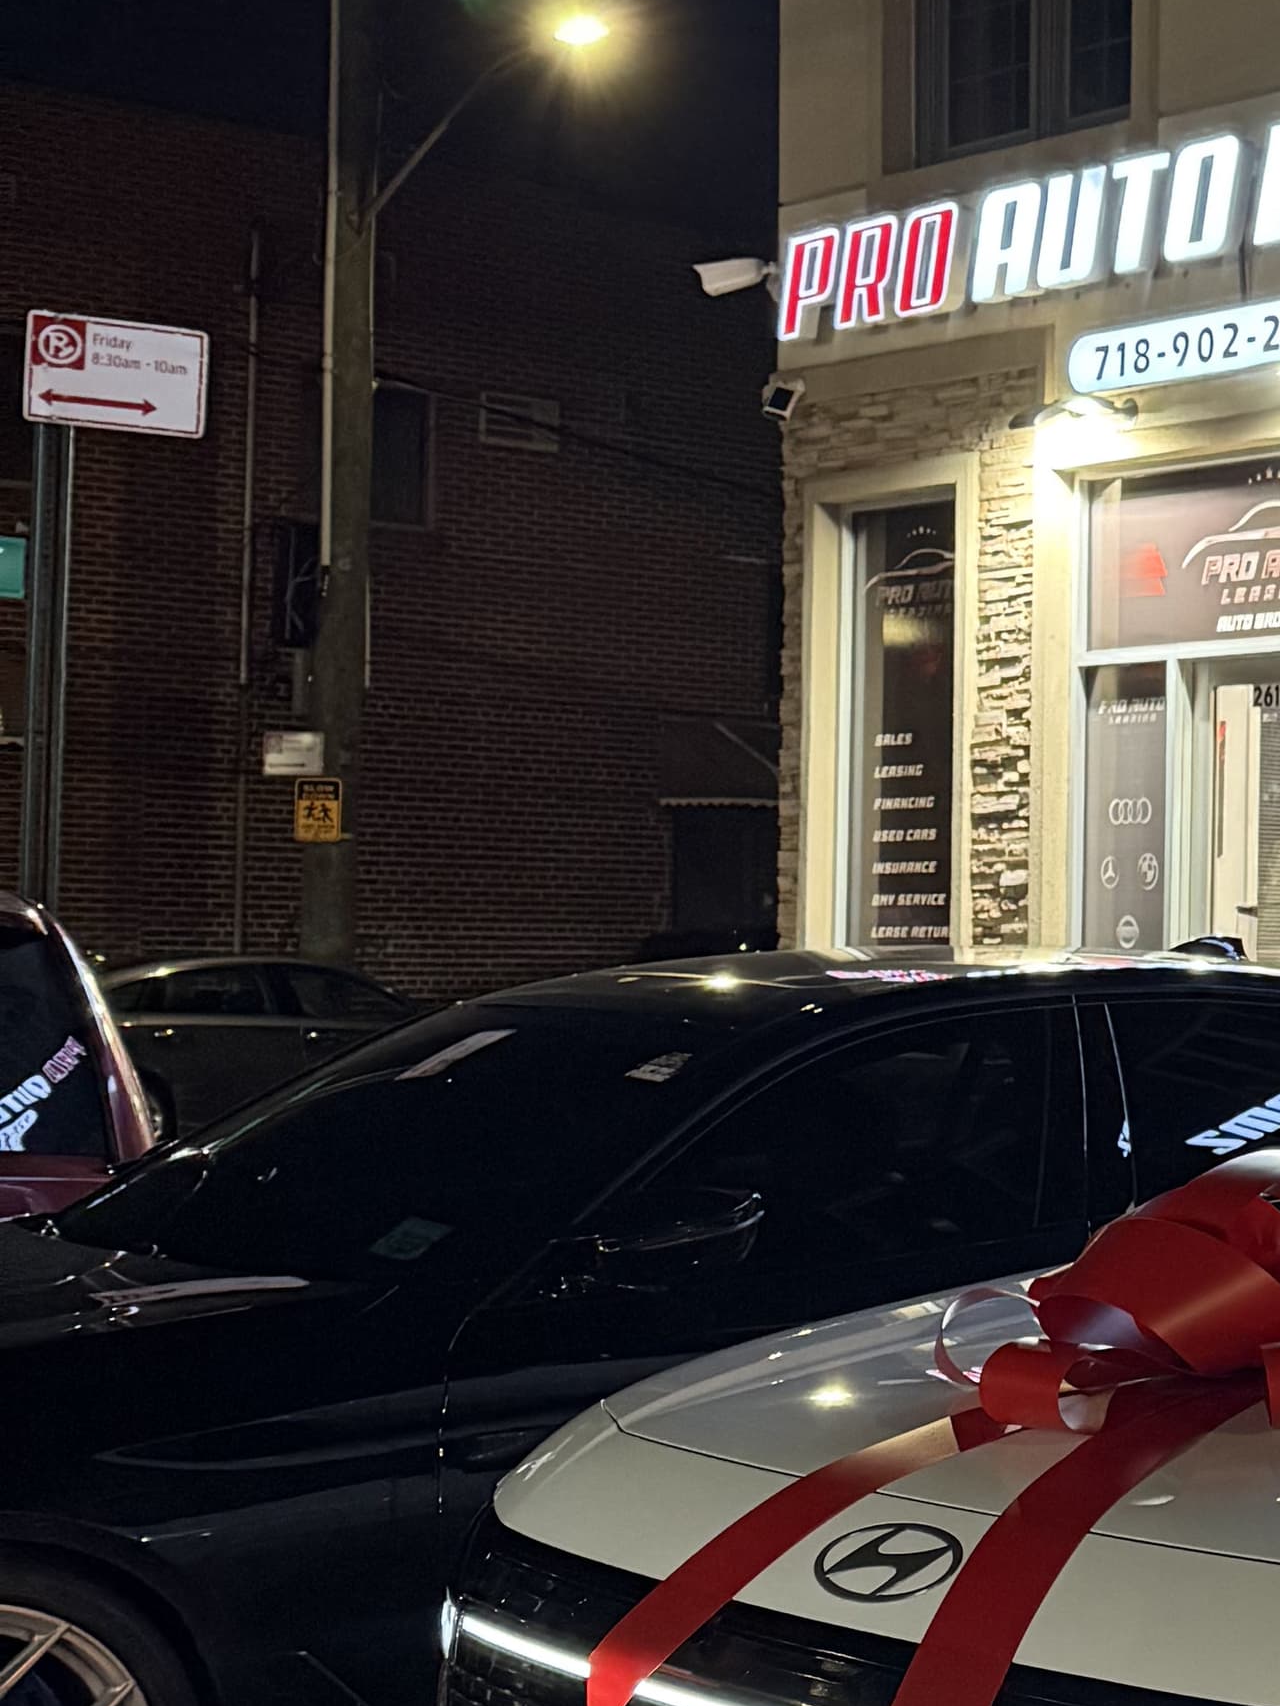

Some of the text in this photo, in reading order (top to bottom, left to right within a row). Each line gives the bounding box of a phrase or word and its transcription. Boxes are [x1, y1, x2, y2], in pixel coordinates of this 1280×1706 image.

[781, 202, 957, 339] PRO
[972, 135, 1246, 307] AUTO
[92, 333, 132, 351] Friday
[92, 353, 141, 370] 8:30am
[154, 360, 188, 375] 10am
[1202, 551, 1260, 585] PRO
[1216, 613, 1253, 633] AUTO
[875, 733, 912, 746] SALES
[874, 764, 923, 778] LEASING
[873, 796, 935, 810] FINANCING
[873, 828, 937, 842] USED CARS
[872, 861, 937, 874] INSURANCE
[897, 893, 946, 906] SERVICE
[871, 926, 908, 938] LEASE
